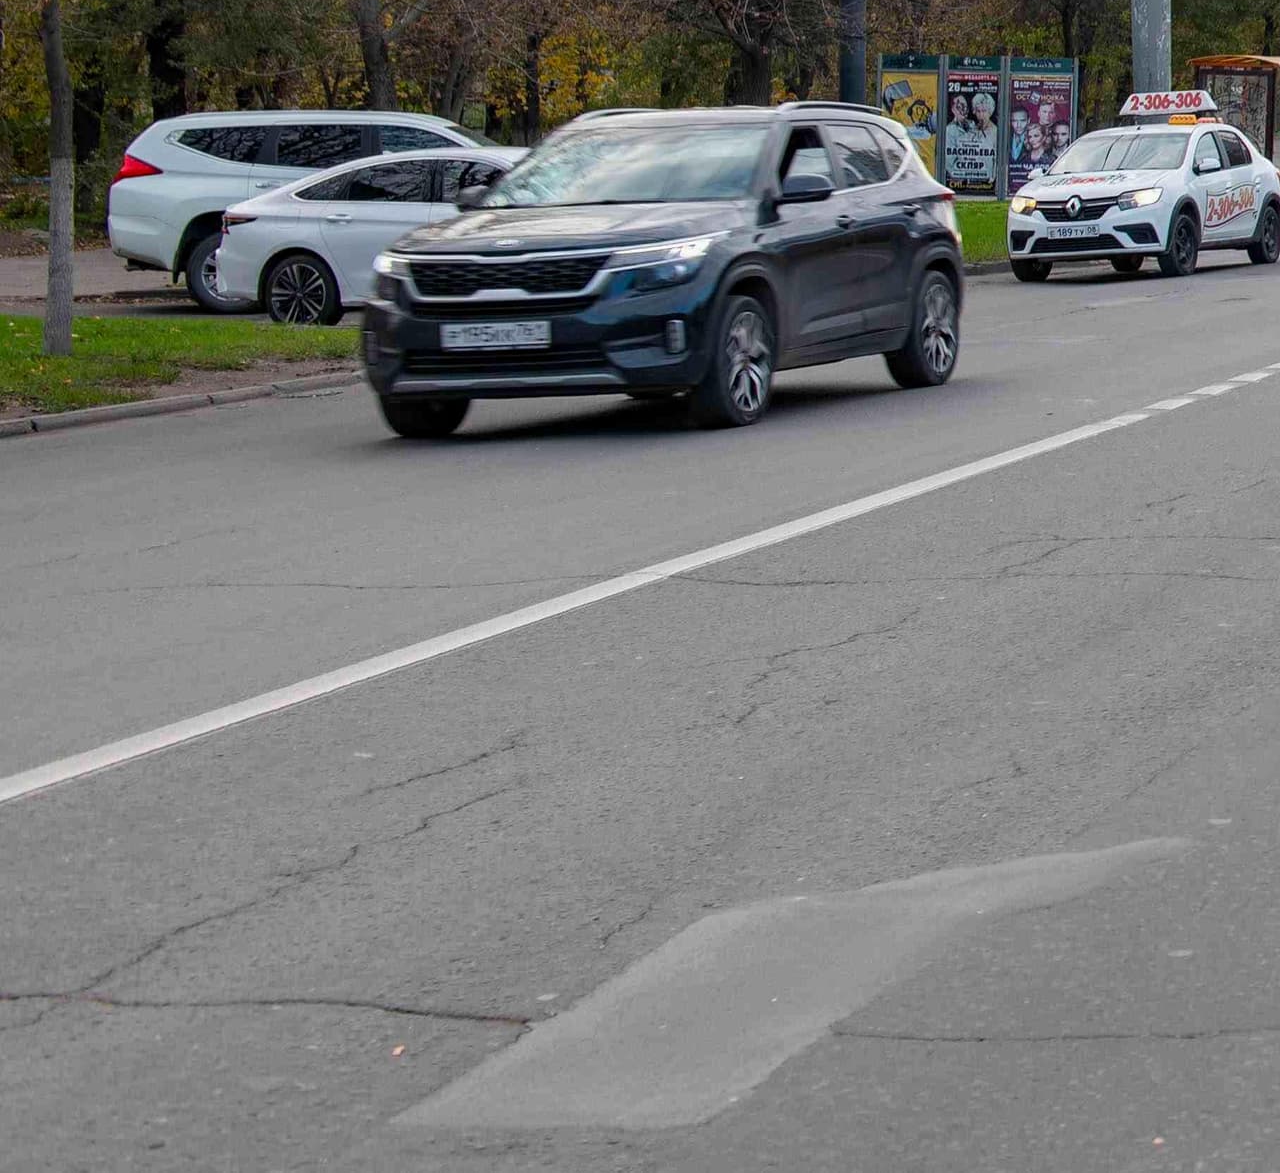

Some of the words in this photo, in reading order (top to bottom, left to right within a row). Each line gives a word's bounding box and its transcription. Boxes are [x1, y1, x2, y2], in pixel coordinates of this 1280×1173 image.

[1130, 92, 1202, 111] 2-306-306
[946, 148, 996, 156] ВАСИЛЬЕВА
[1206, 188, 1255, 222] 2-306-306
